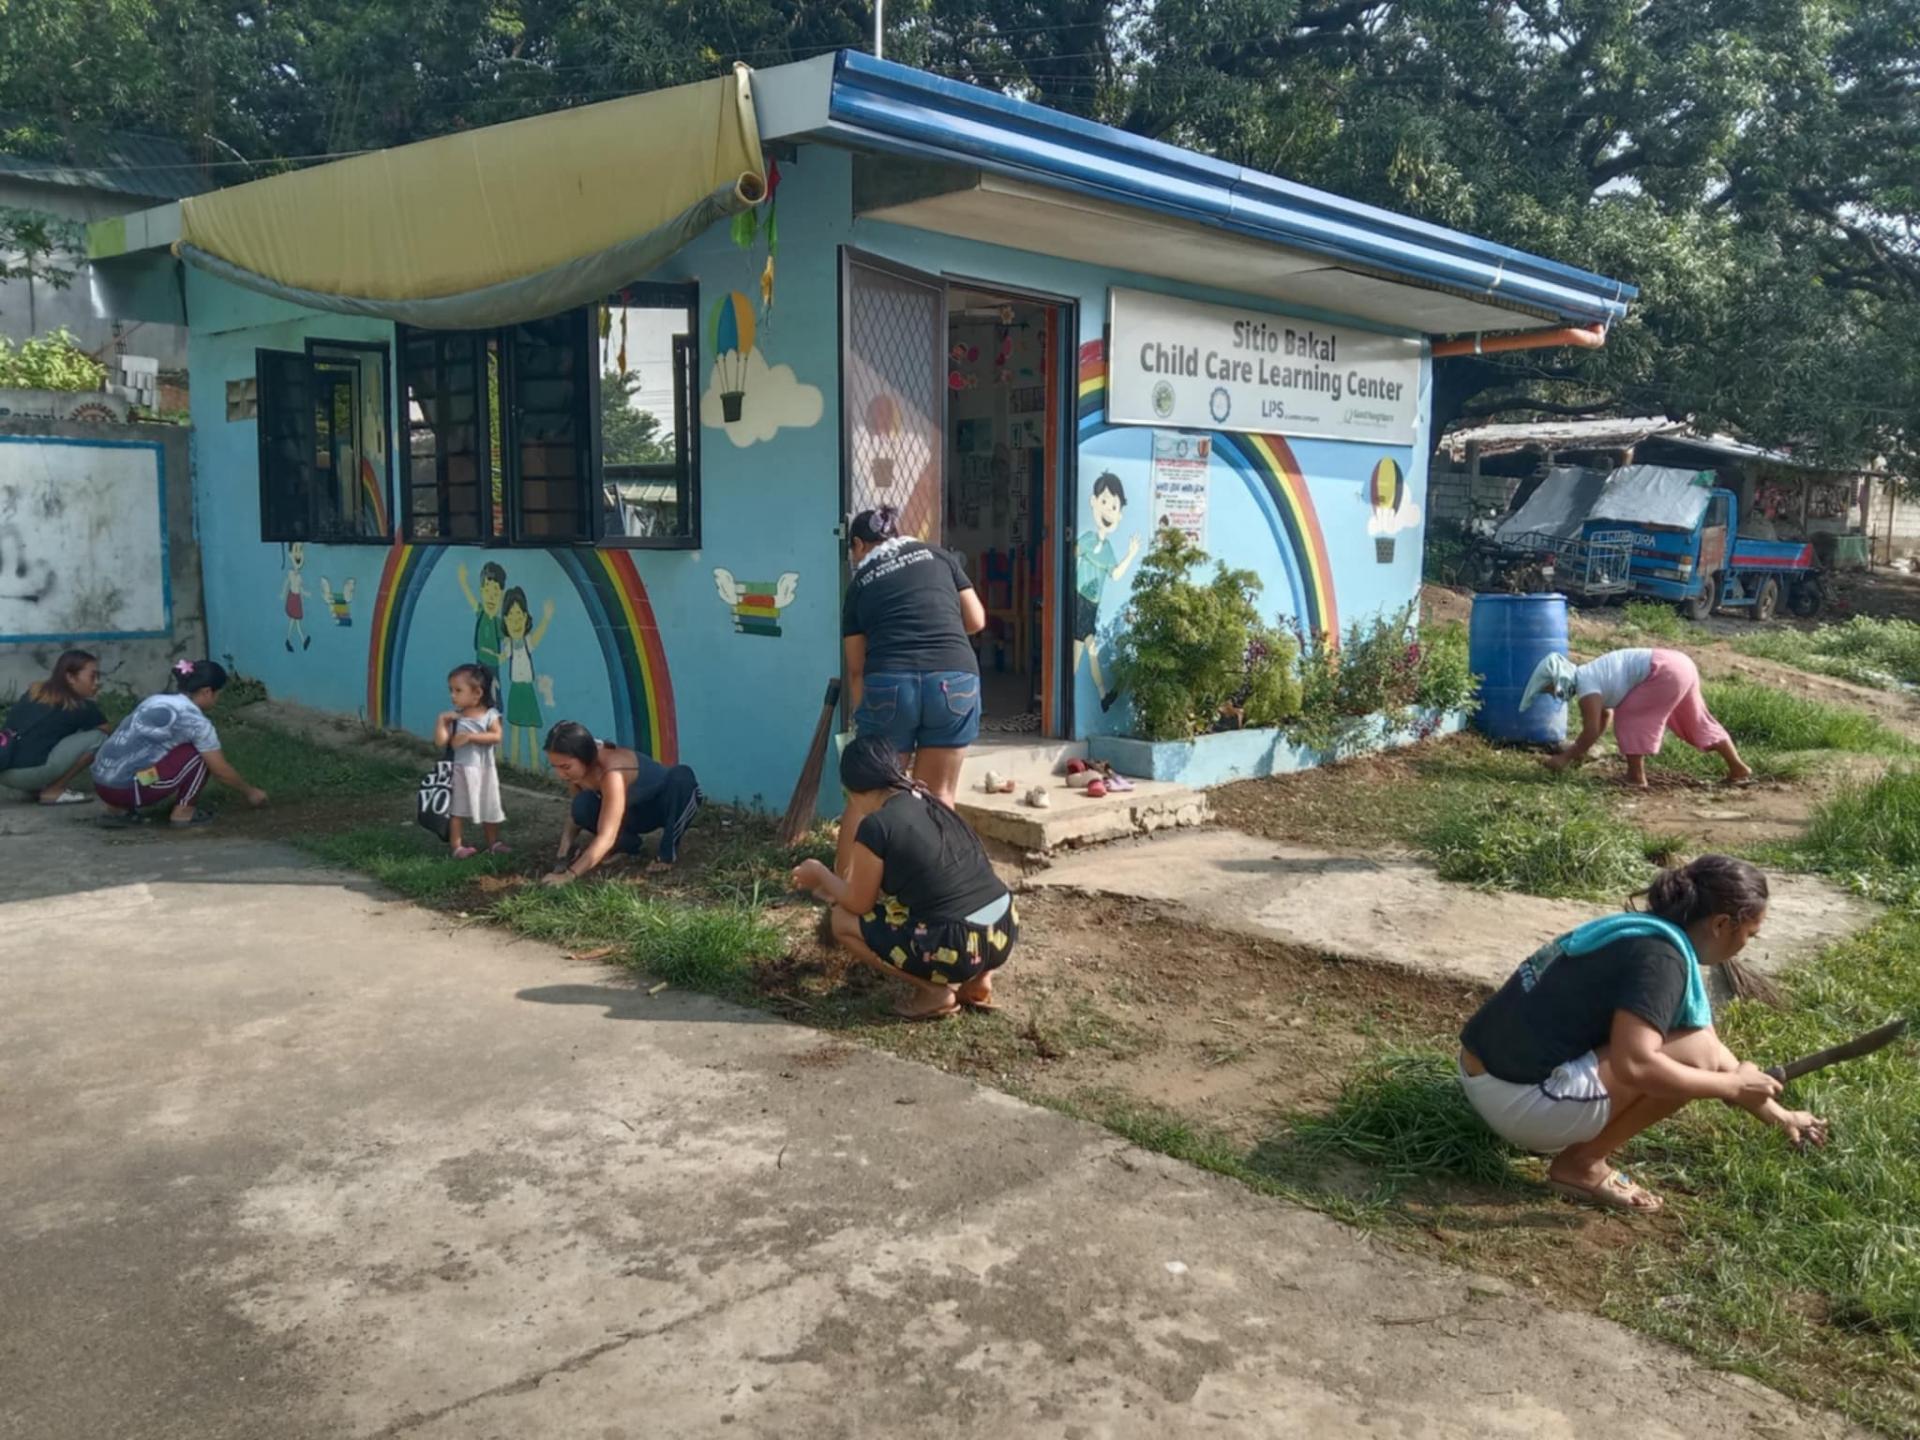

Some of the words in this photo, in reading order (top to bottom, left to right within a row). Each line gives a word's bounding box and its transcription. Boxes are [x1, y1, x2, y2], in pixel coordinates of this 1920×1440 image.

[1232, 320, 1279, 353] Sitio
[1284, 328, 1336, 362] Bakal
[1140, 342, 1199, 377] Child
[1205, 351, 1253, 383] Care
[1258, 357, 1342, 401] Learning
[1346, 370, 1403, 401] Center
[1261, 399, 1285, 419] LPS
